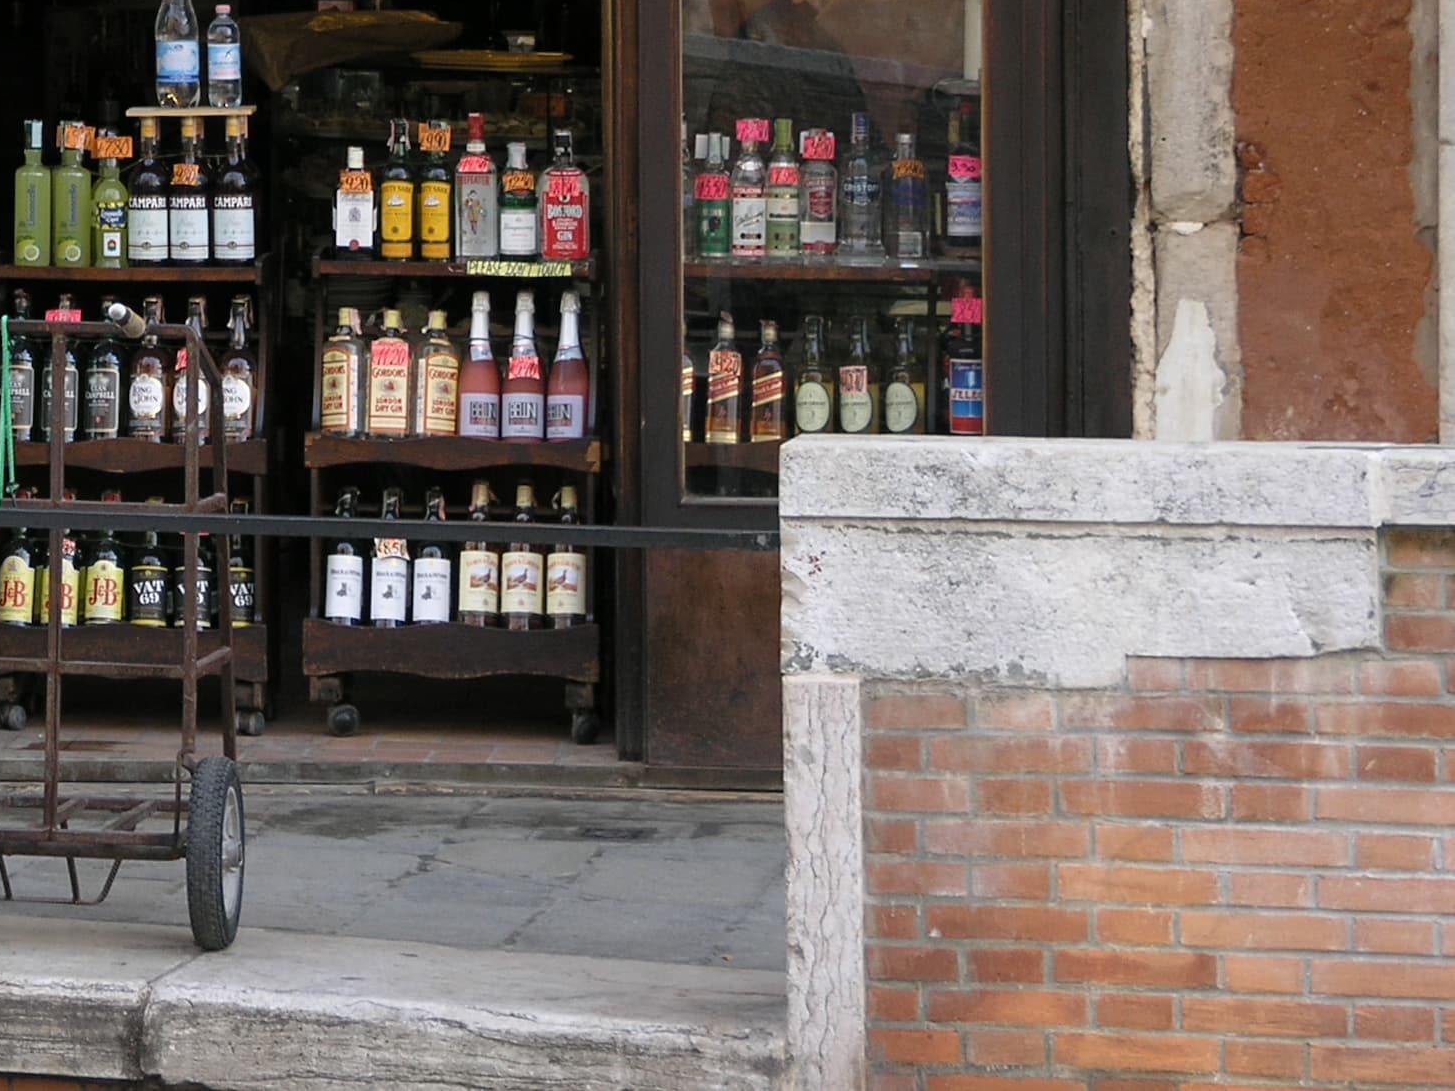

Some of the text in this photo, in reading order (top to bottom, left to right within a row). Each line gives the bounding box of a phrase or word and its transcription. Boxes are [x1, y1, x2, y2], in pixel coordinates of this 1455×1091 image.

[0, 580, 26, 608] J&B
[88, 577, 117, 606] J&B
[133, 580, 165, 595] VAT
[139, 592, 160, 605] 69
